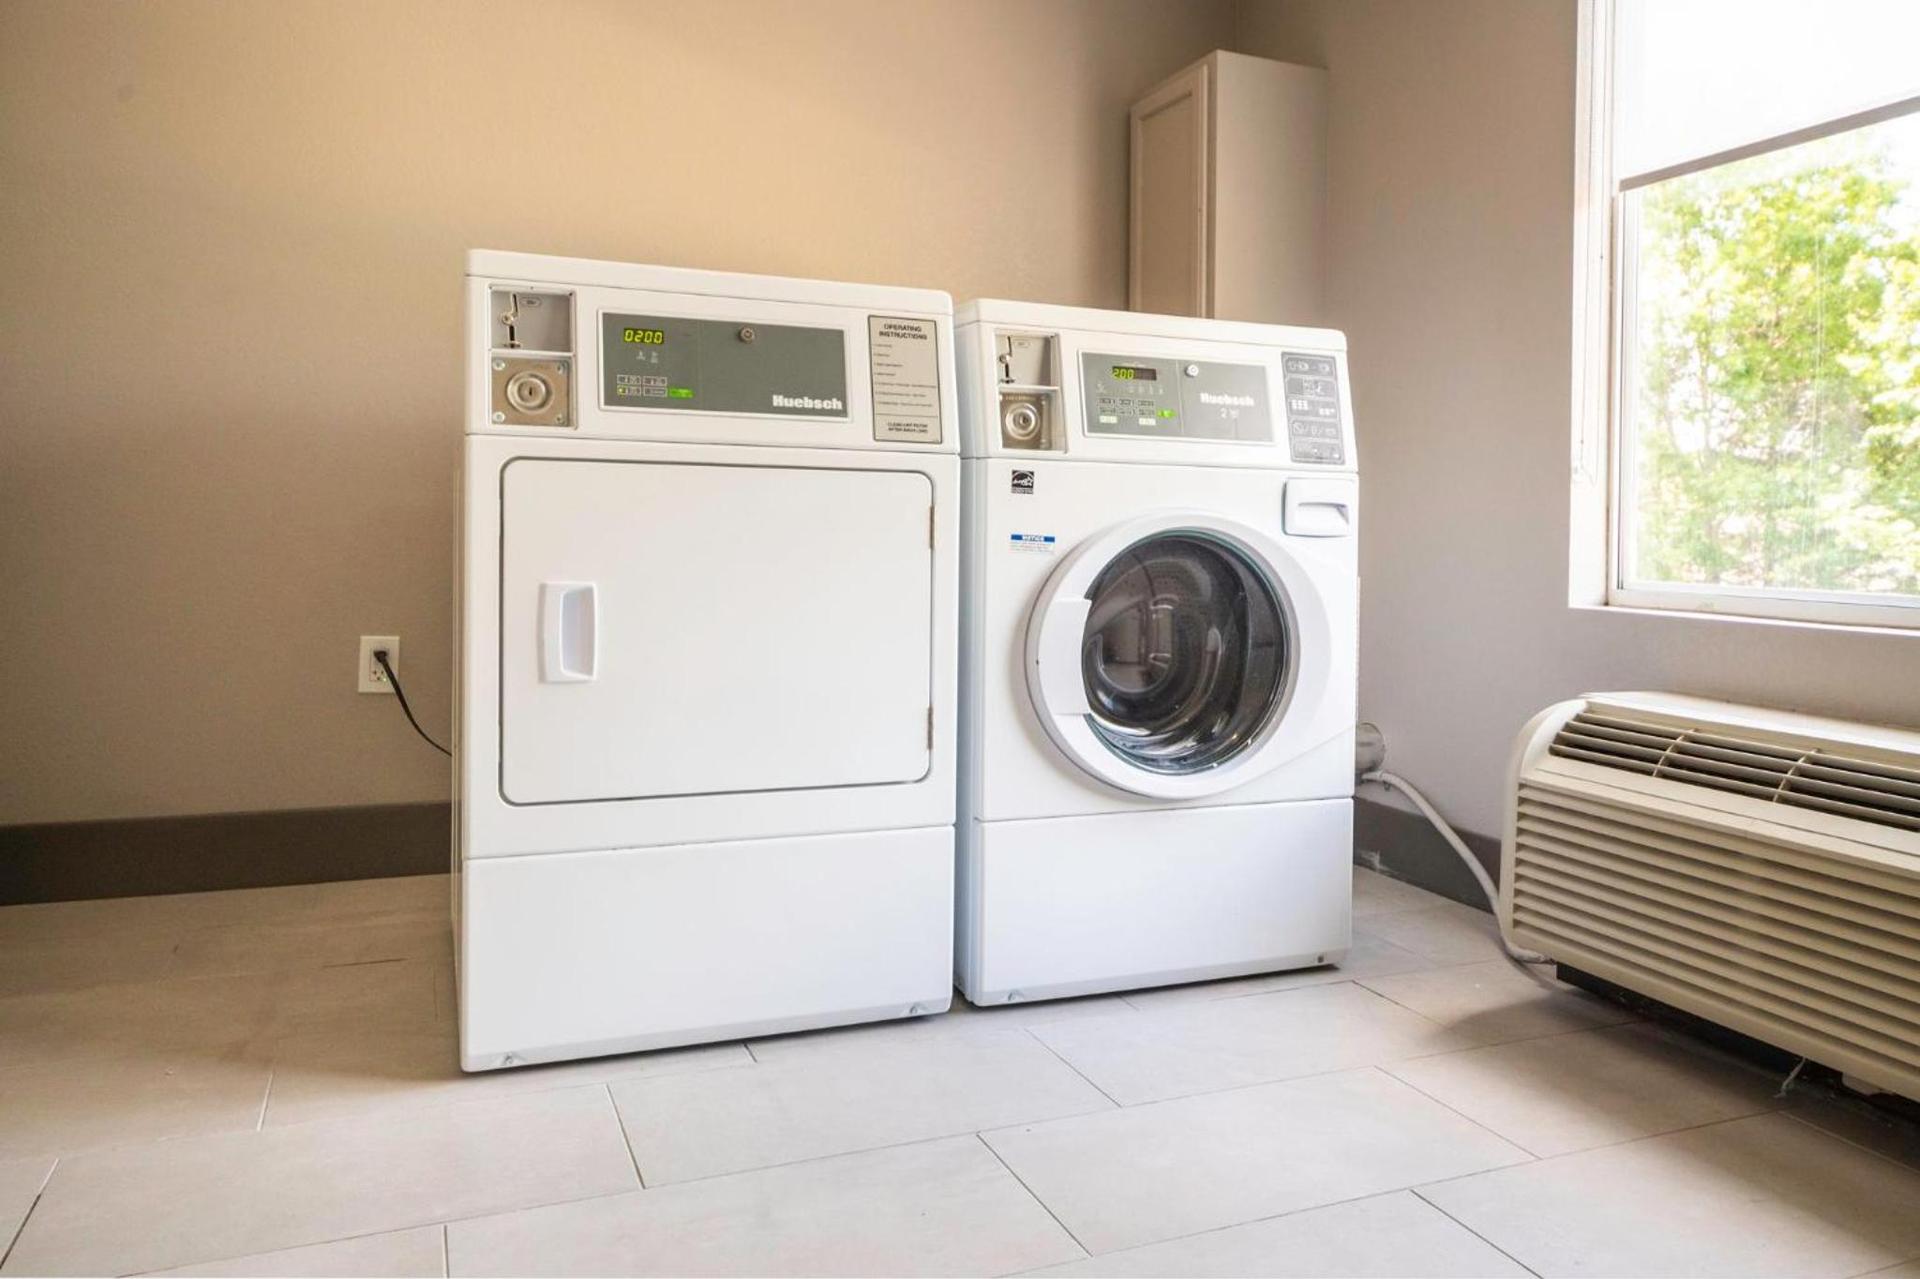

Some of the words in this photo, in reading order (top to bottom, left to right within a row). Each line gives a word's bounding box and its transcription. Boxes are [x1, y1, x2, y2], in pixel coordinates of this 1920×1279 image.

[884, 323, 921, 332] OPERATING
[624, 329, 664, 344] 0200
[879, 331, 927, 340] INSTRUCTIONS
[1112, 368, 1135, 380] 200
[772, 394, 843, 411] Huebsch
[1200, 393, 1254, 406] Huebsch
